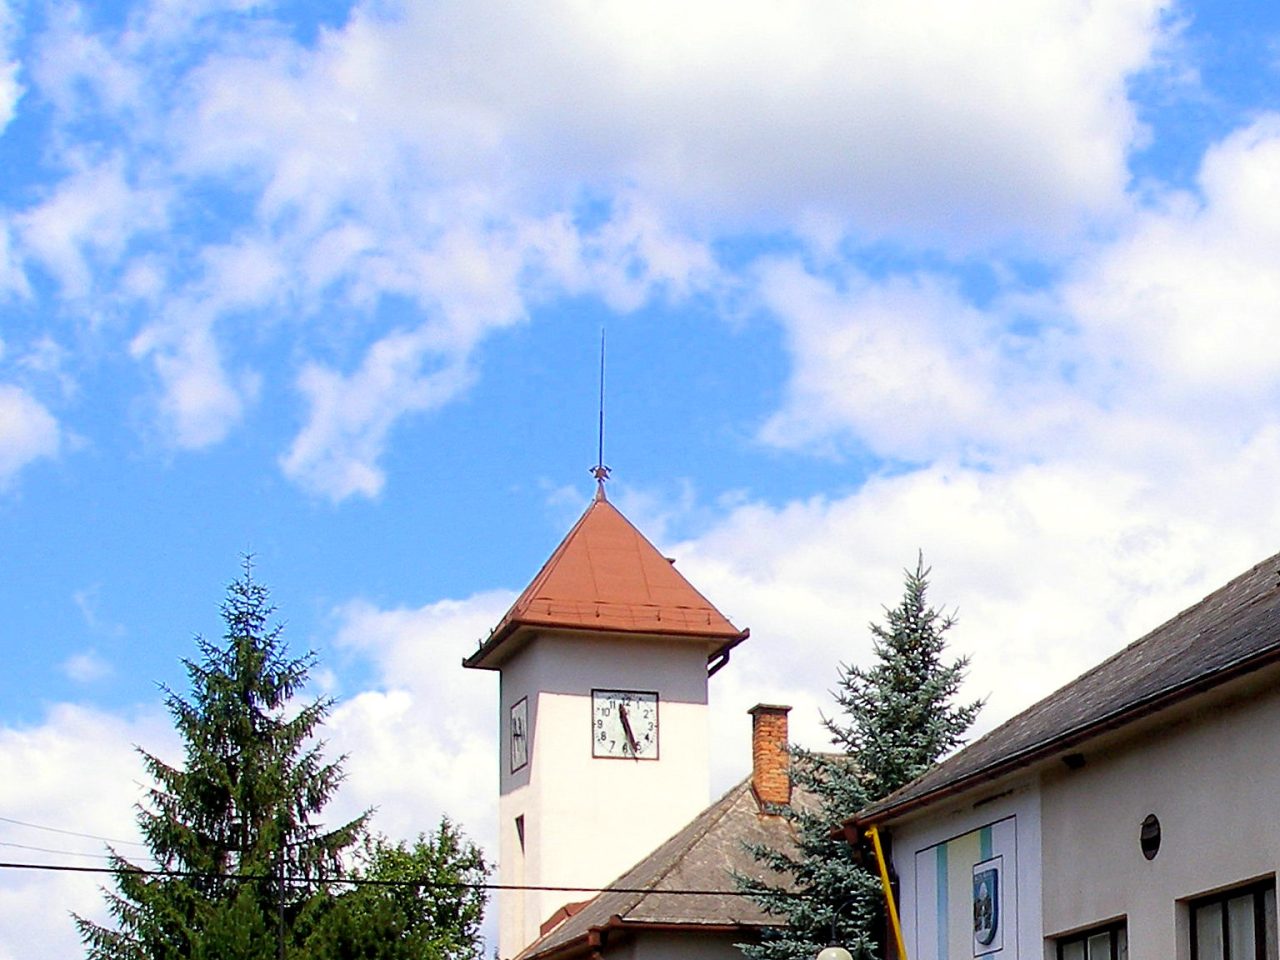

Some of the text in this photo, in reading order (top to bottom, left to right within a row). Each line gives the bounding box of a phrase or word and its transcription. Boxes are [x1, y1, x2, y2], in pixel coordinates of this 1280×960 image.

[609, 700, 616, 709] 11
[622, 696, 631, 706] 12
[601, 708, 610, 717] 10
[643, 709, 649, 719] 2
[597, 719, 603, 729] 9
[648, 722, 654, 731] 3
[600, 731, 606, 741] 8
[644, 733, 650, 742] 4
[610, 741, 615, 750] 7
[622, 742, 628, 753] 6
